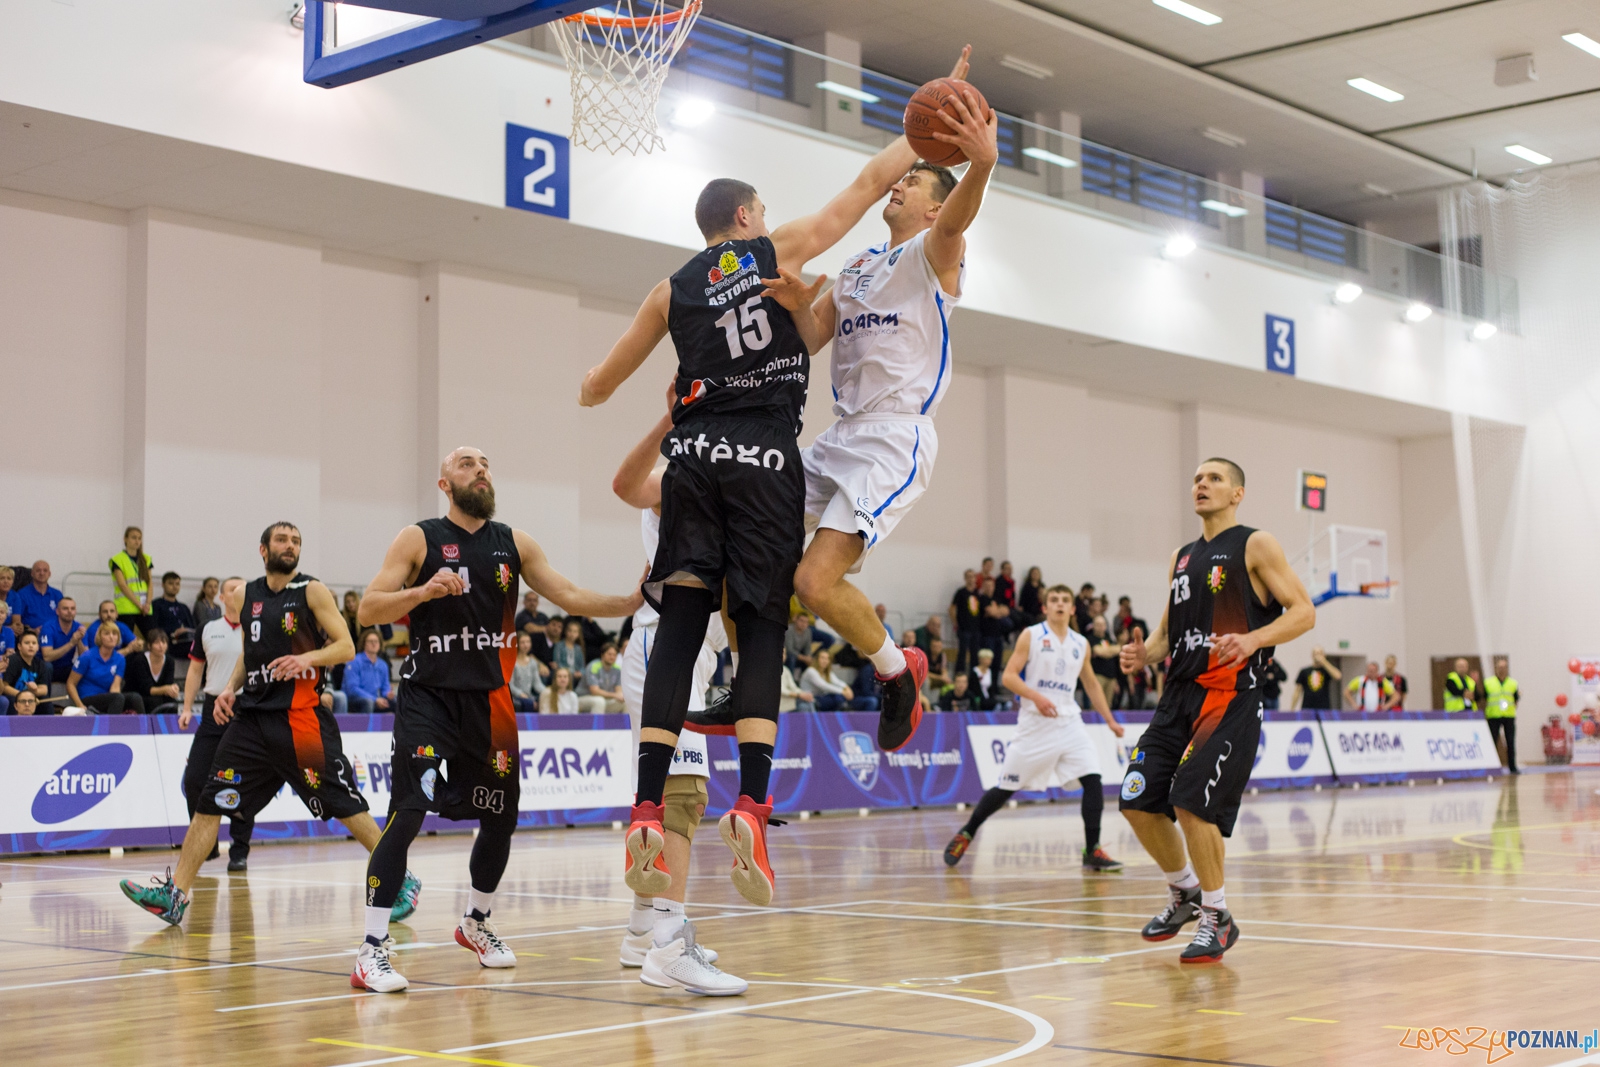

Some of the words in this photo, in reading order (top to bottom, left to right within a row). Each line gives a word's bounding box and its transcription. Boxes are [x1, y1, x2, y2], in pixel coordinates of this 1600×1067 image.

[524, 137, 555, 208] 2
[708, 274, 761, 306] ASTORIA
[714, 295, 773, 360] 15
[1273, 320, 1291, 369] 3
[1171, 574, 1191, 606] 23
[250, 620, 262, 643] 9
[683, 750, 703, 765] PBG
[1338, 733, 1404, 753] BIOFARM
[45, 769, 117, 796] atrem
[473, 786, 505, 814] 84
